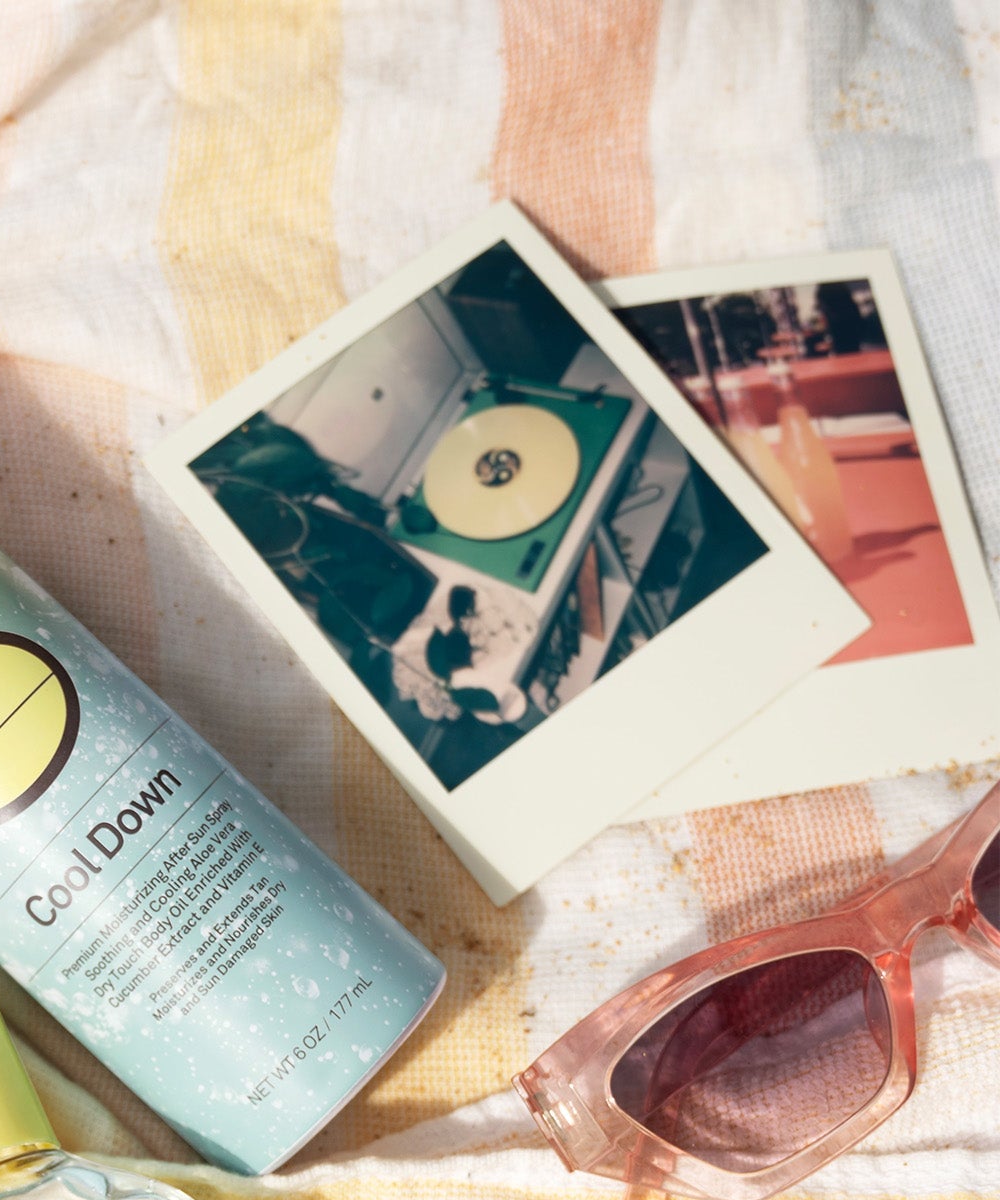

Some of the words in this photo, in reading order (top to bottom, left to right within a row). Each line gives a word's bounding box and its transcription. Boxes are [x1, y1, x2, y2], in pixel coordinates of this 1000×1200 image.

[24, 847, 103, 927] Cool
[85, 768, 183, 861] Down
[60, 937, 105, 980] Premium
[98, 869, 170, 940] Moisturizing
[162, 841, 192, 874] After
[186, 823, 211, 846] Sun
[204, 801, 233, 826] Spray
[84, 933, 135, 982] Soothing
[133, 908, 153, 933] and
[148, 866, 197, 913] Cooling
[189, 843, 216, 871] Aloe
[209, 822, 237, 845] Vera
[92, 978, 116, 999] Dry
[107, 947, 145, 981] Touch
[139, 915, 174, 949] Body
[168, 897, 190, 919] Oil
[183, 848, 234, 902] Enriched
[226, 830, 253, 854] With
[108, 954, 161, 1009] Cucumber
[156, 912, 202, 958] Extract
[198, 887, 223, 916] and
[216, 851, 258, 891] Vitamin
[251, 841, 265, 855] E
[148, 954, 199, 1004] Preserves
[195, 932, 218, 957] and
[212, 893, 255, 936] Extends
[248, 876, 270, 895] Tan
[151, 965, 209, 1021] Moisturizes
[206, 942, 228, 968] and
[223, 897, 273, 947] Nourishes
[266, 880, 287, 899] Dry
[179, 992, 201, 1017] and
[197, 974, 221, 995] Sun
[216, 924, 265, 976] Damaged
[260, 904, 285, 929] Skin
[246, 1075, 276, 1106] NET
[270, 1054, 296, 1081] WT
[292, 1046, 307, 1061] 6
[302, 1024, 327, 1050] OZ
[328, 992, 353, 1020] 177
[351, 976, 373, 999] mL
